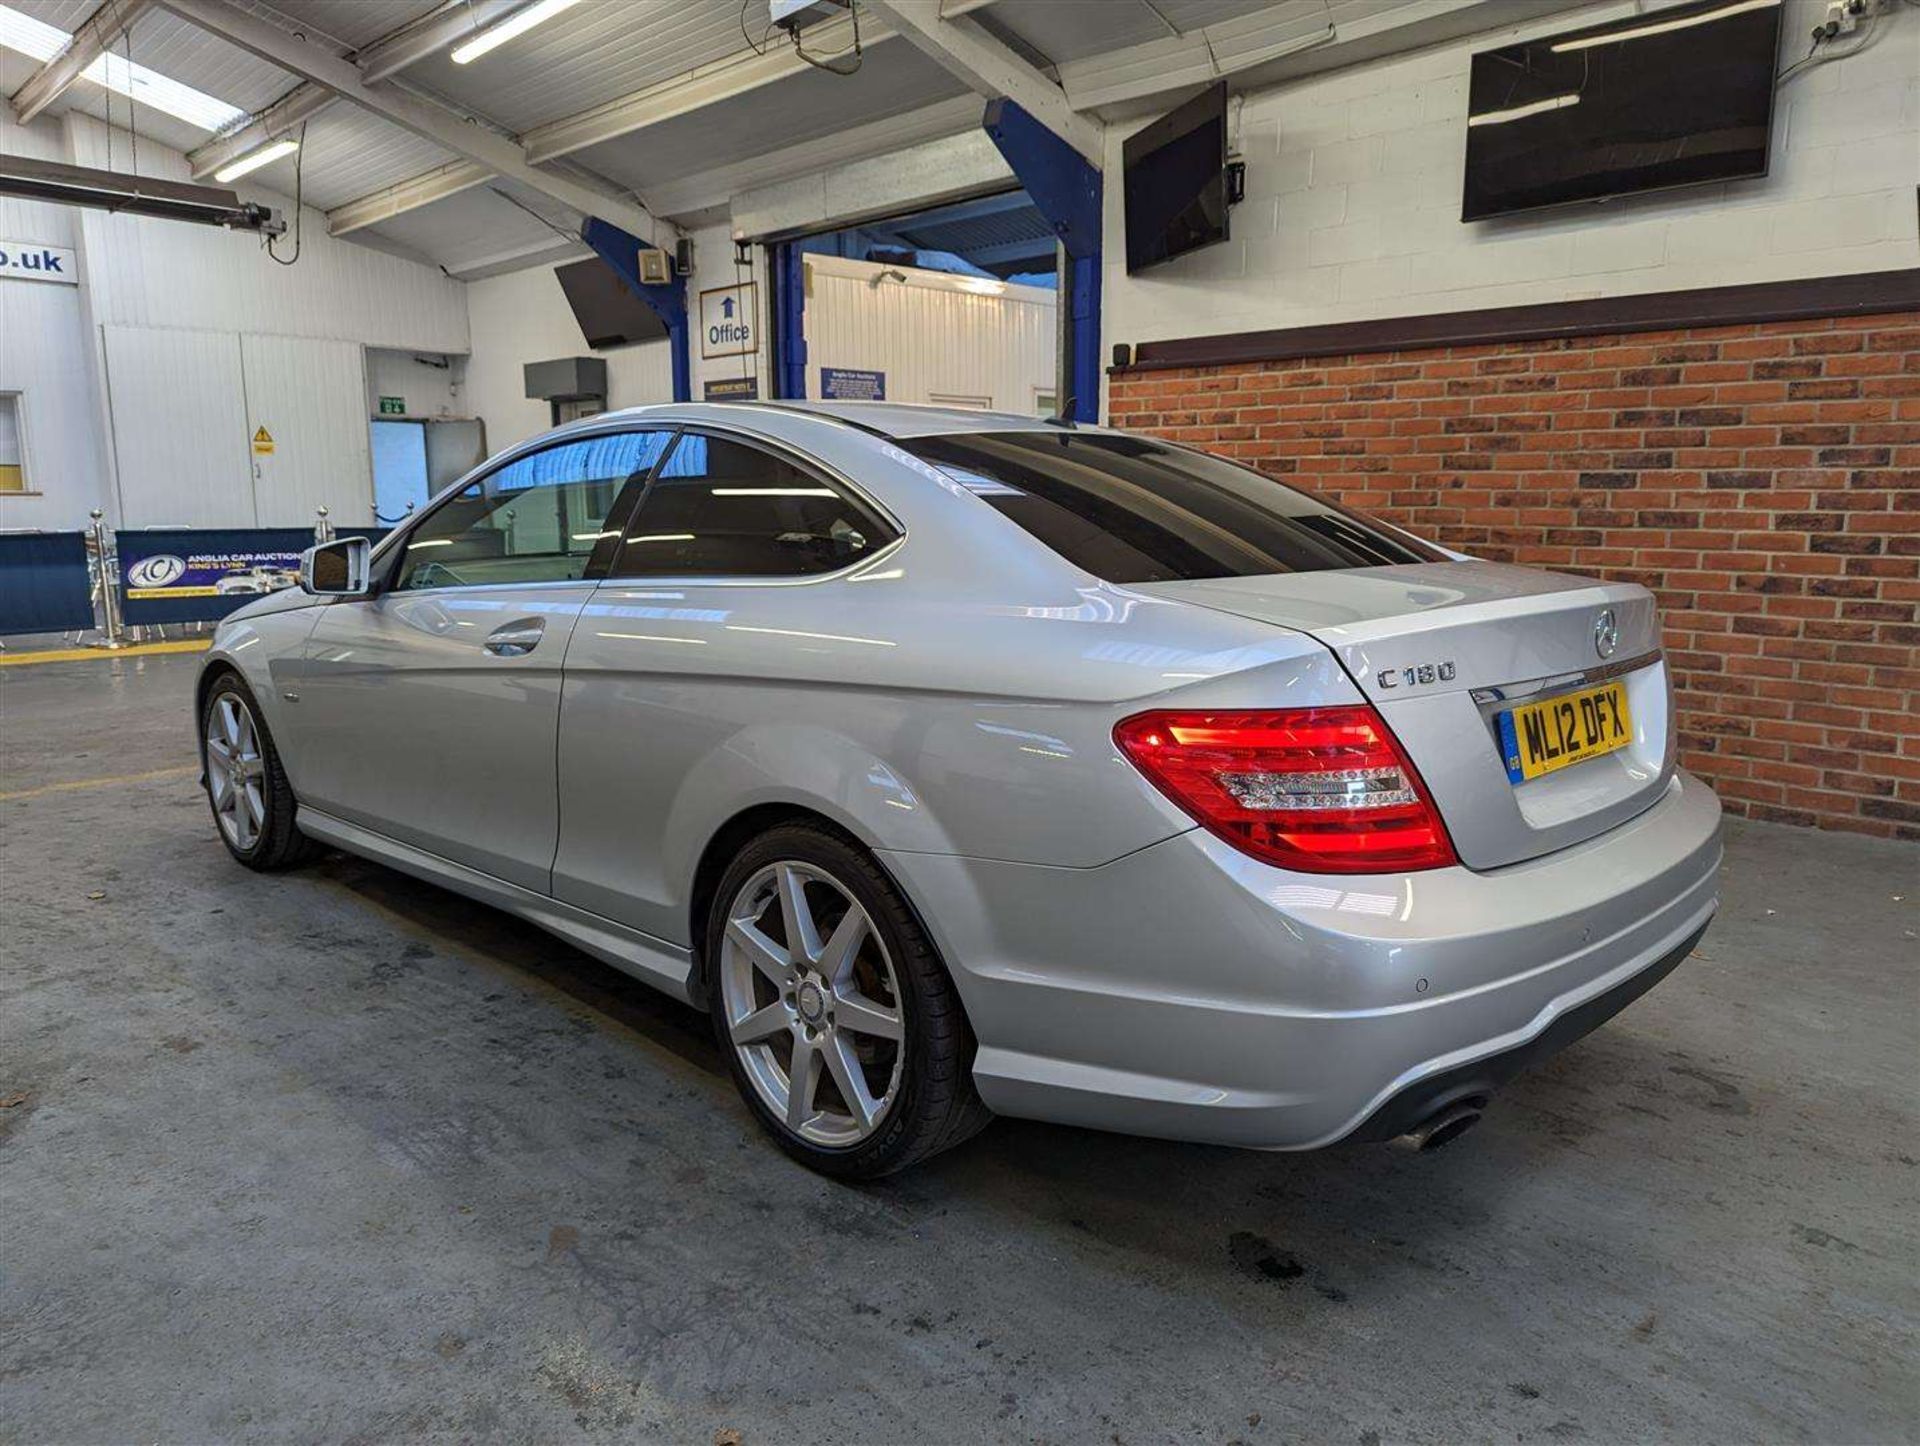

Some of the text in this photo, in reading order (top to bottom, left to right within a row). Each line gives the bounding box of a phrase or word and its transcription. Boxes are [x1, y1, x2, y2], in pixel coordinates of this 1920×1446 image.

[709, 324, 749, 344] Office
[188, 555, 229, 563] ANGLIA
[231, 554, 254, 562] CAR
[1377, 669, 1398, 689] C
[1523, 689, 1625, 765] ML12 DFX
